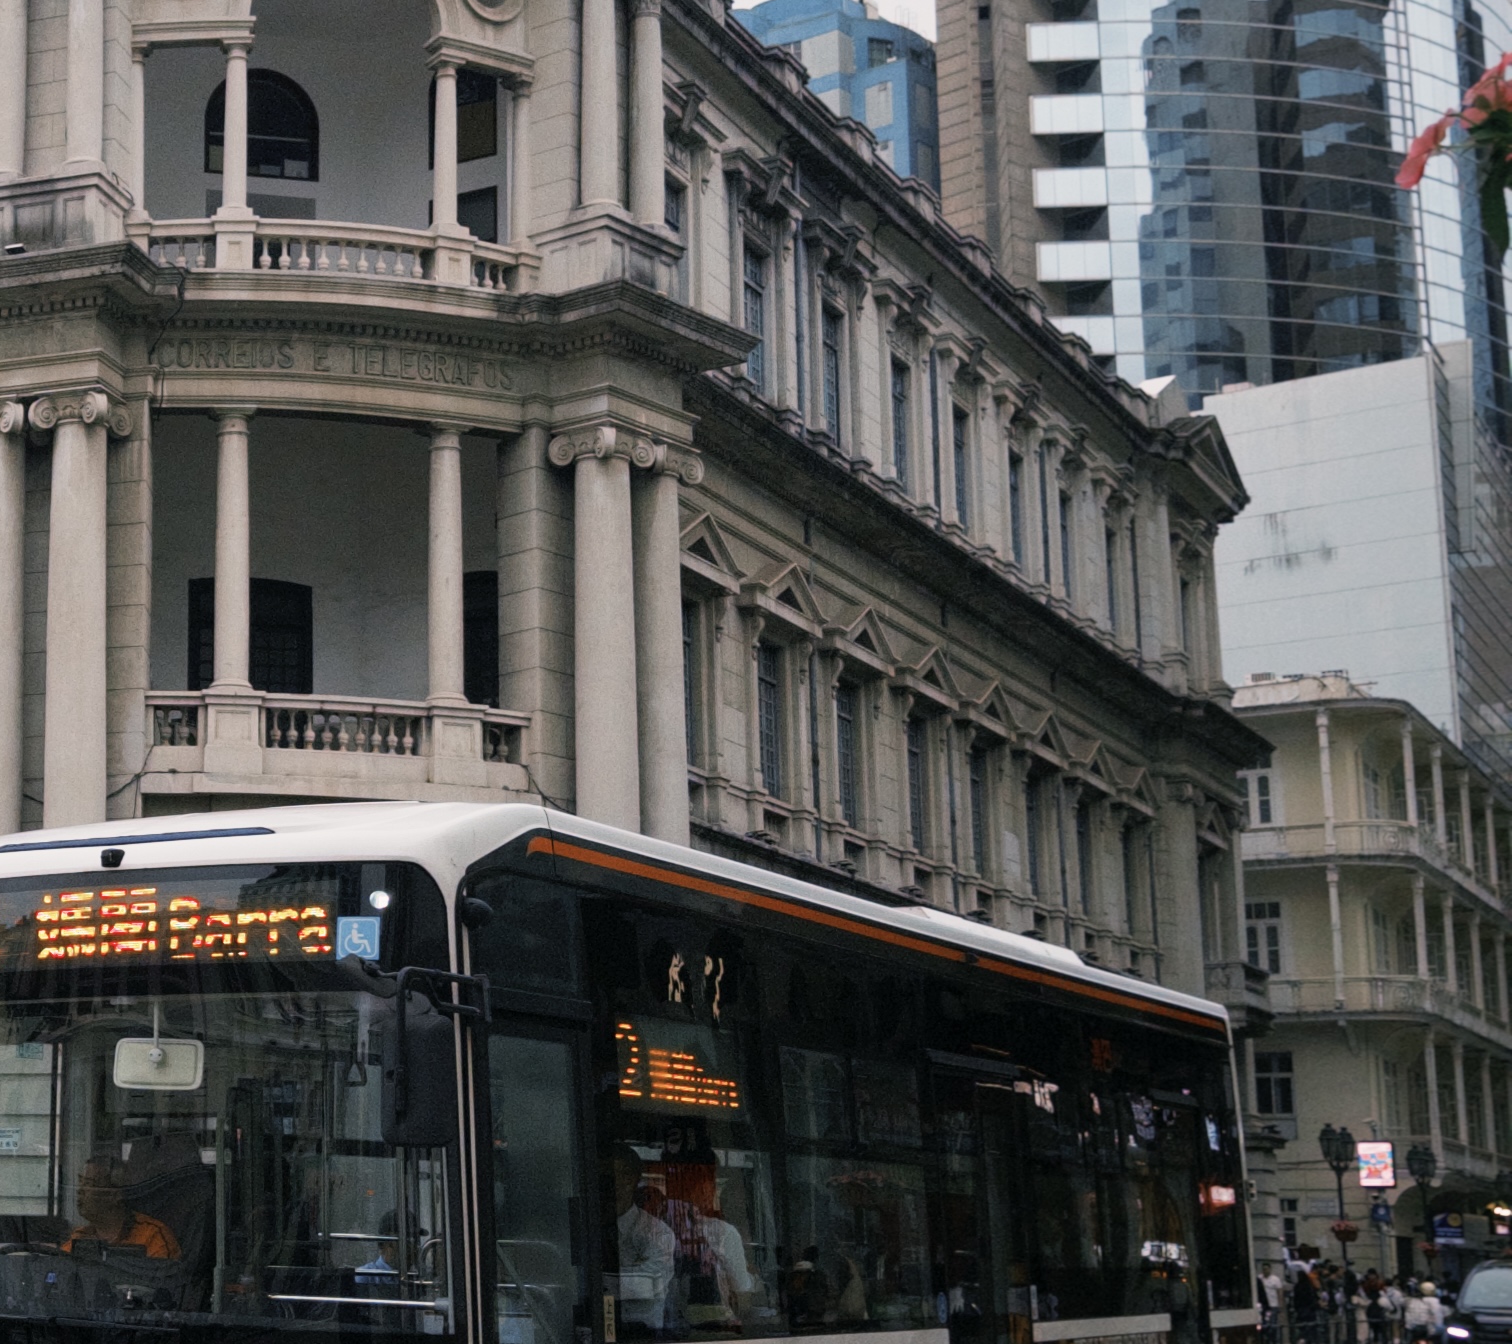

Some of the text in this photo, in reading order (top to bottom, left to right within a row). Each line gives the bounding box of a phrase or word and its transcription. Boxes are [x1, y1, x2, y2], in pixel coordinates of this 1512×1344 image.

[156, 338, 516, 391] CORREIOS E TELEGRAFOS
[614, 1022, 643, 1098] 2
